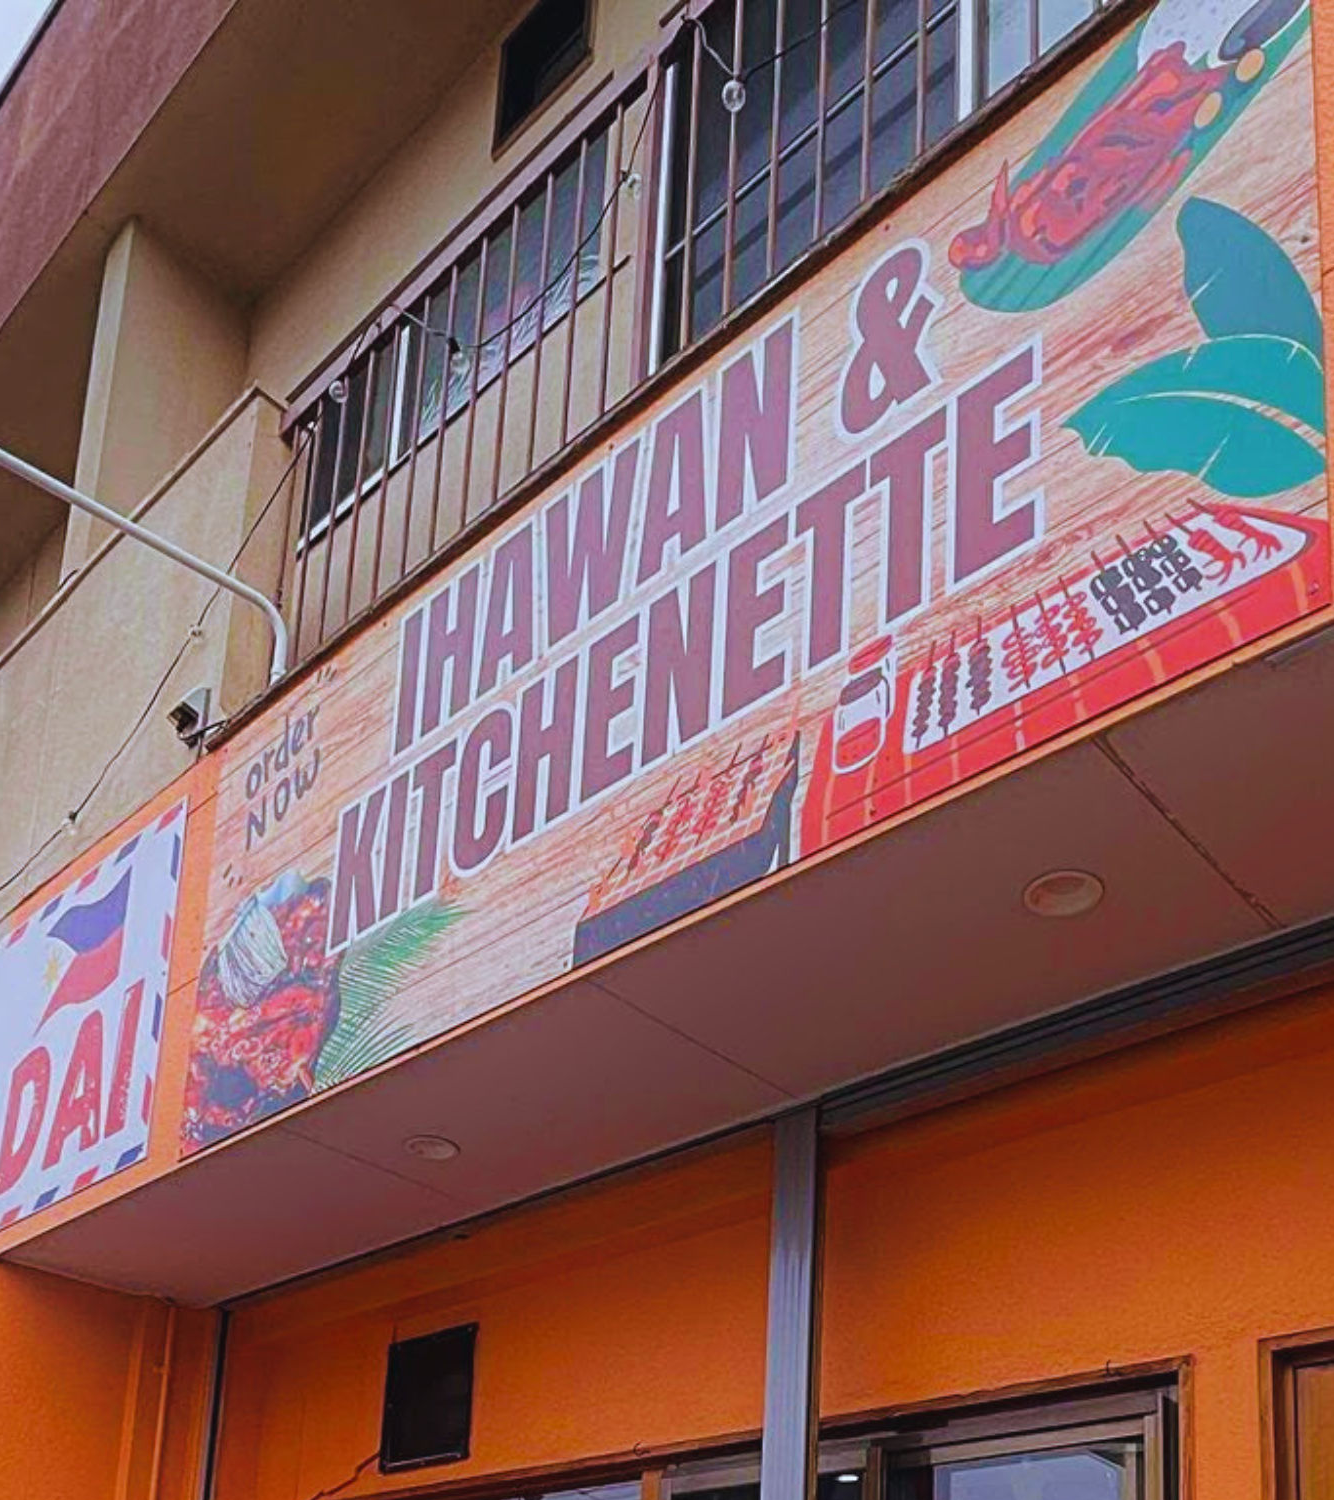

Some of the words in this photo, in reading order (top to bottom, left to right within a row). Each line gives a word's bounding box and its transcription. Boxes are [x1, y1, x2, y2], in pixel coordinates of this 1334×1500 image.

[325, 333, 1045, 957] KITCHENETTE
[392, 314, 799, 756] IHAWAN
[835, 237, 943, 443] &
[245, 747, 320, 851] NOW
[246, 704, 321, 800] order
